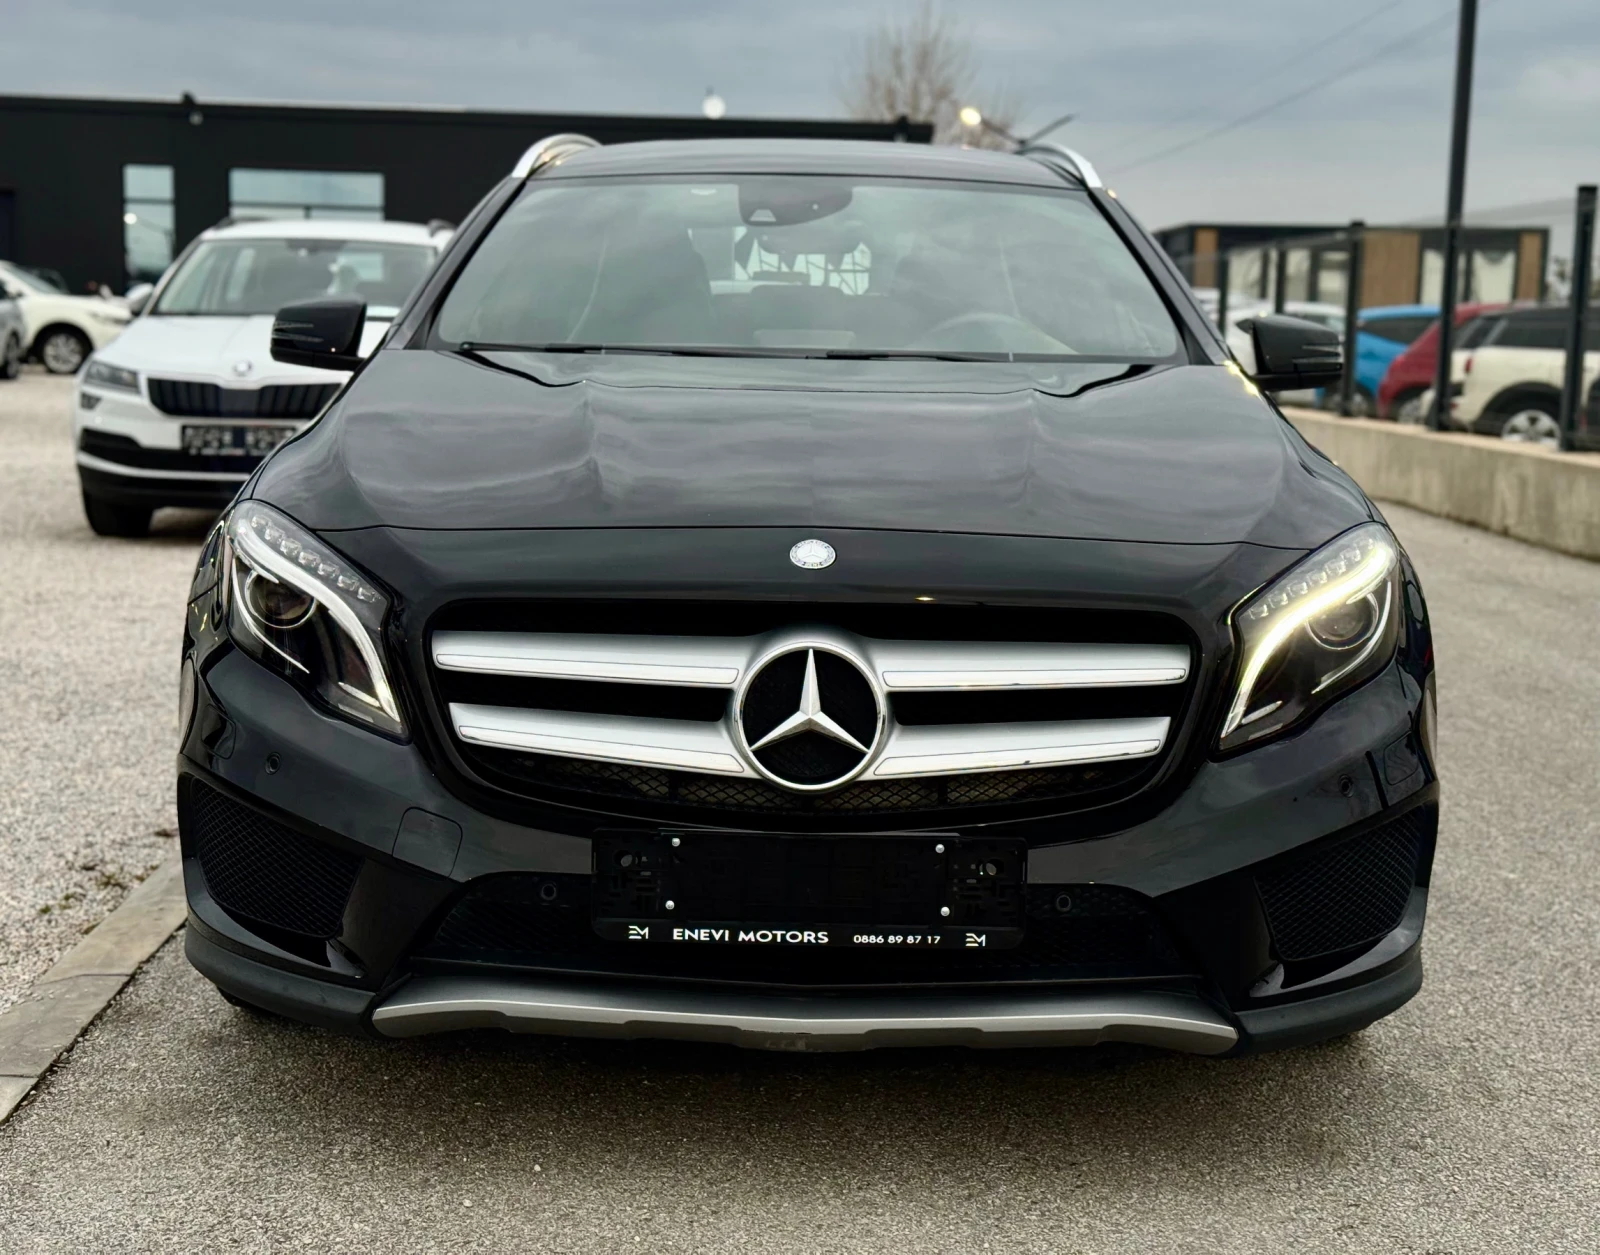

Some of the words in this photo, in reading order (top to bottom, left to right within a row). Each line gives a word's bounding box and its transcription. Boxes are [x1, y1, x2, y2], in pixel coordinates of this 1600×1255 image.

[672, 927, 730, 942] ENEVI
[738, 929, 829, 945] MOTORS
[853, 934, 884, 945] 0886
[887, 934, 904, 945] 89
[906, 935, 922, 945] 87
[926, 935, 941, 946] 17
